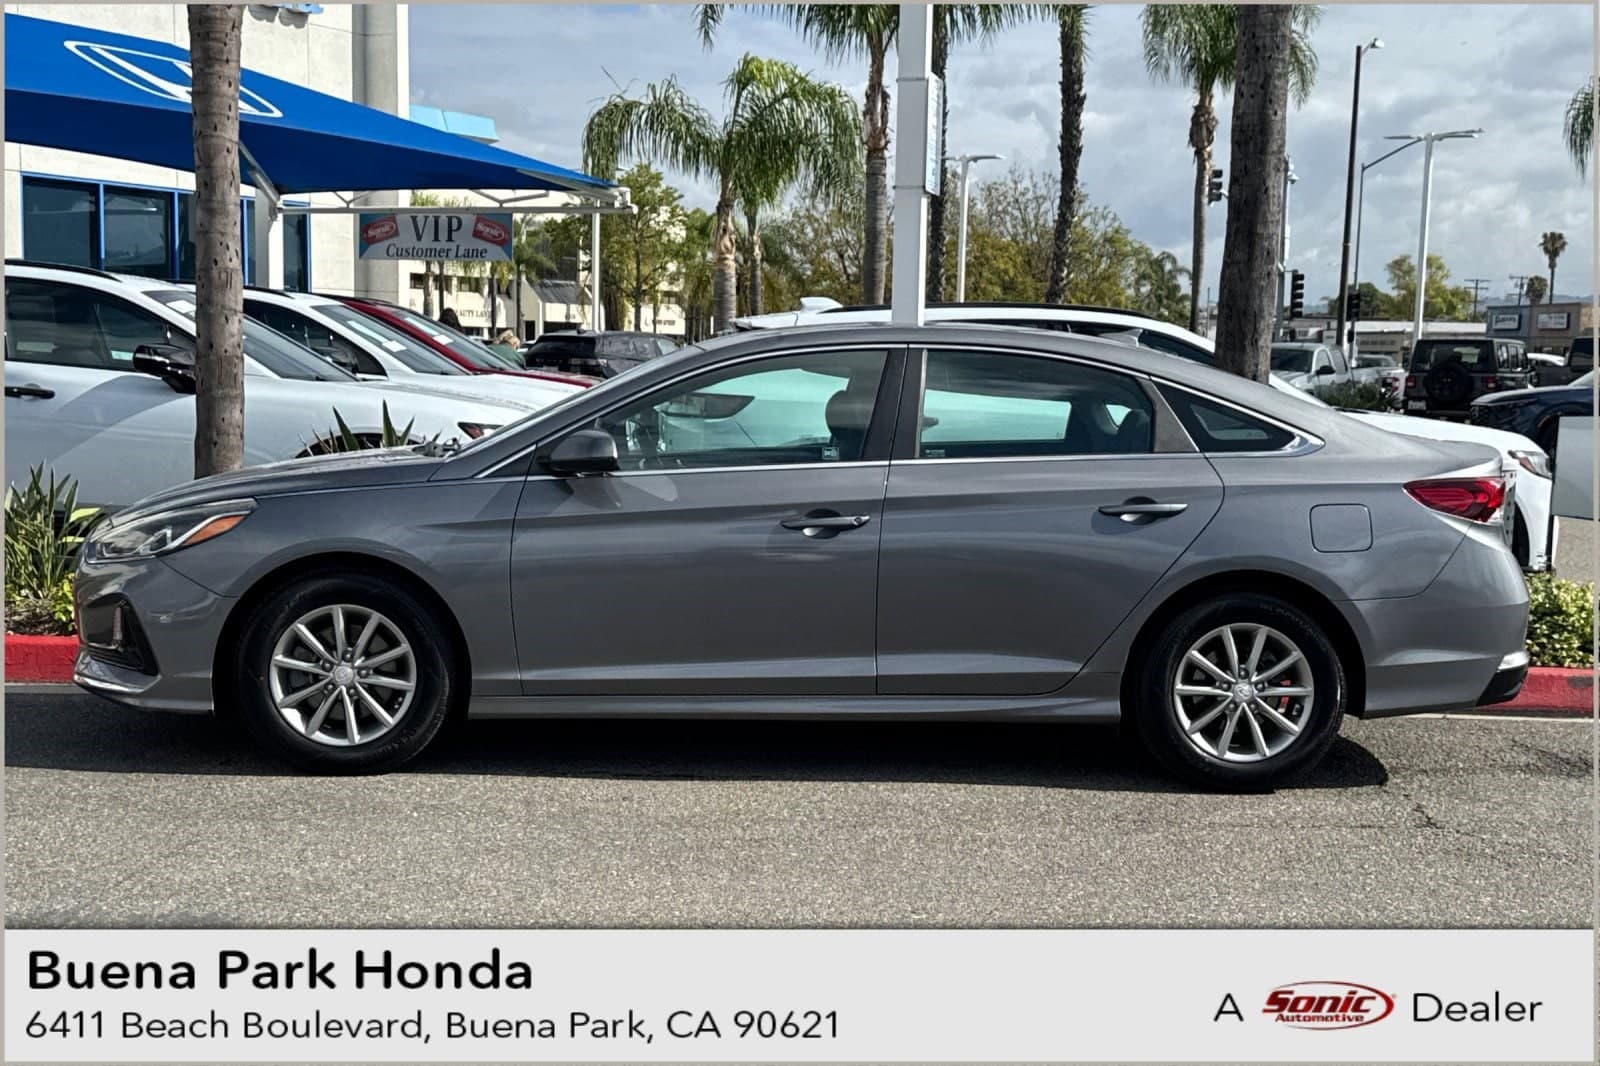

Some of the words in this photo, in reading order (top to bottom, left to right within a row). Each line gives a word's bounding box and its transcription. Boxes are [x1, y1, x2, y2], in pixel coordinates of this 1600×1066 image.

[410, 215, 463, 242] VIP
[386, 243, 453, 258] Customer
[455, 244, 488, 258] Lane
